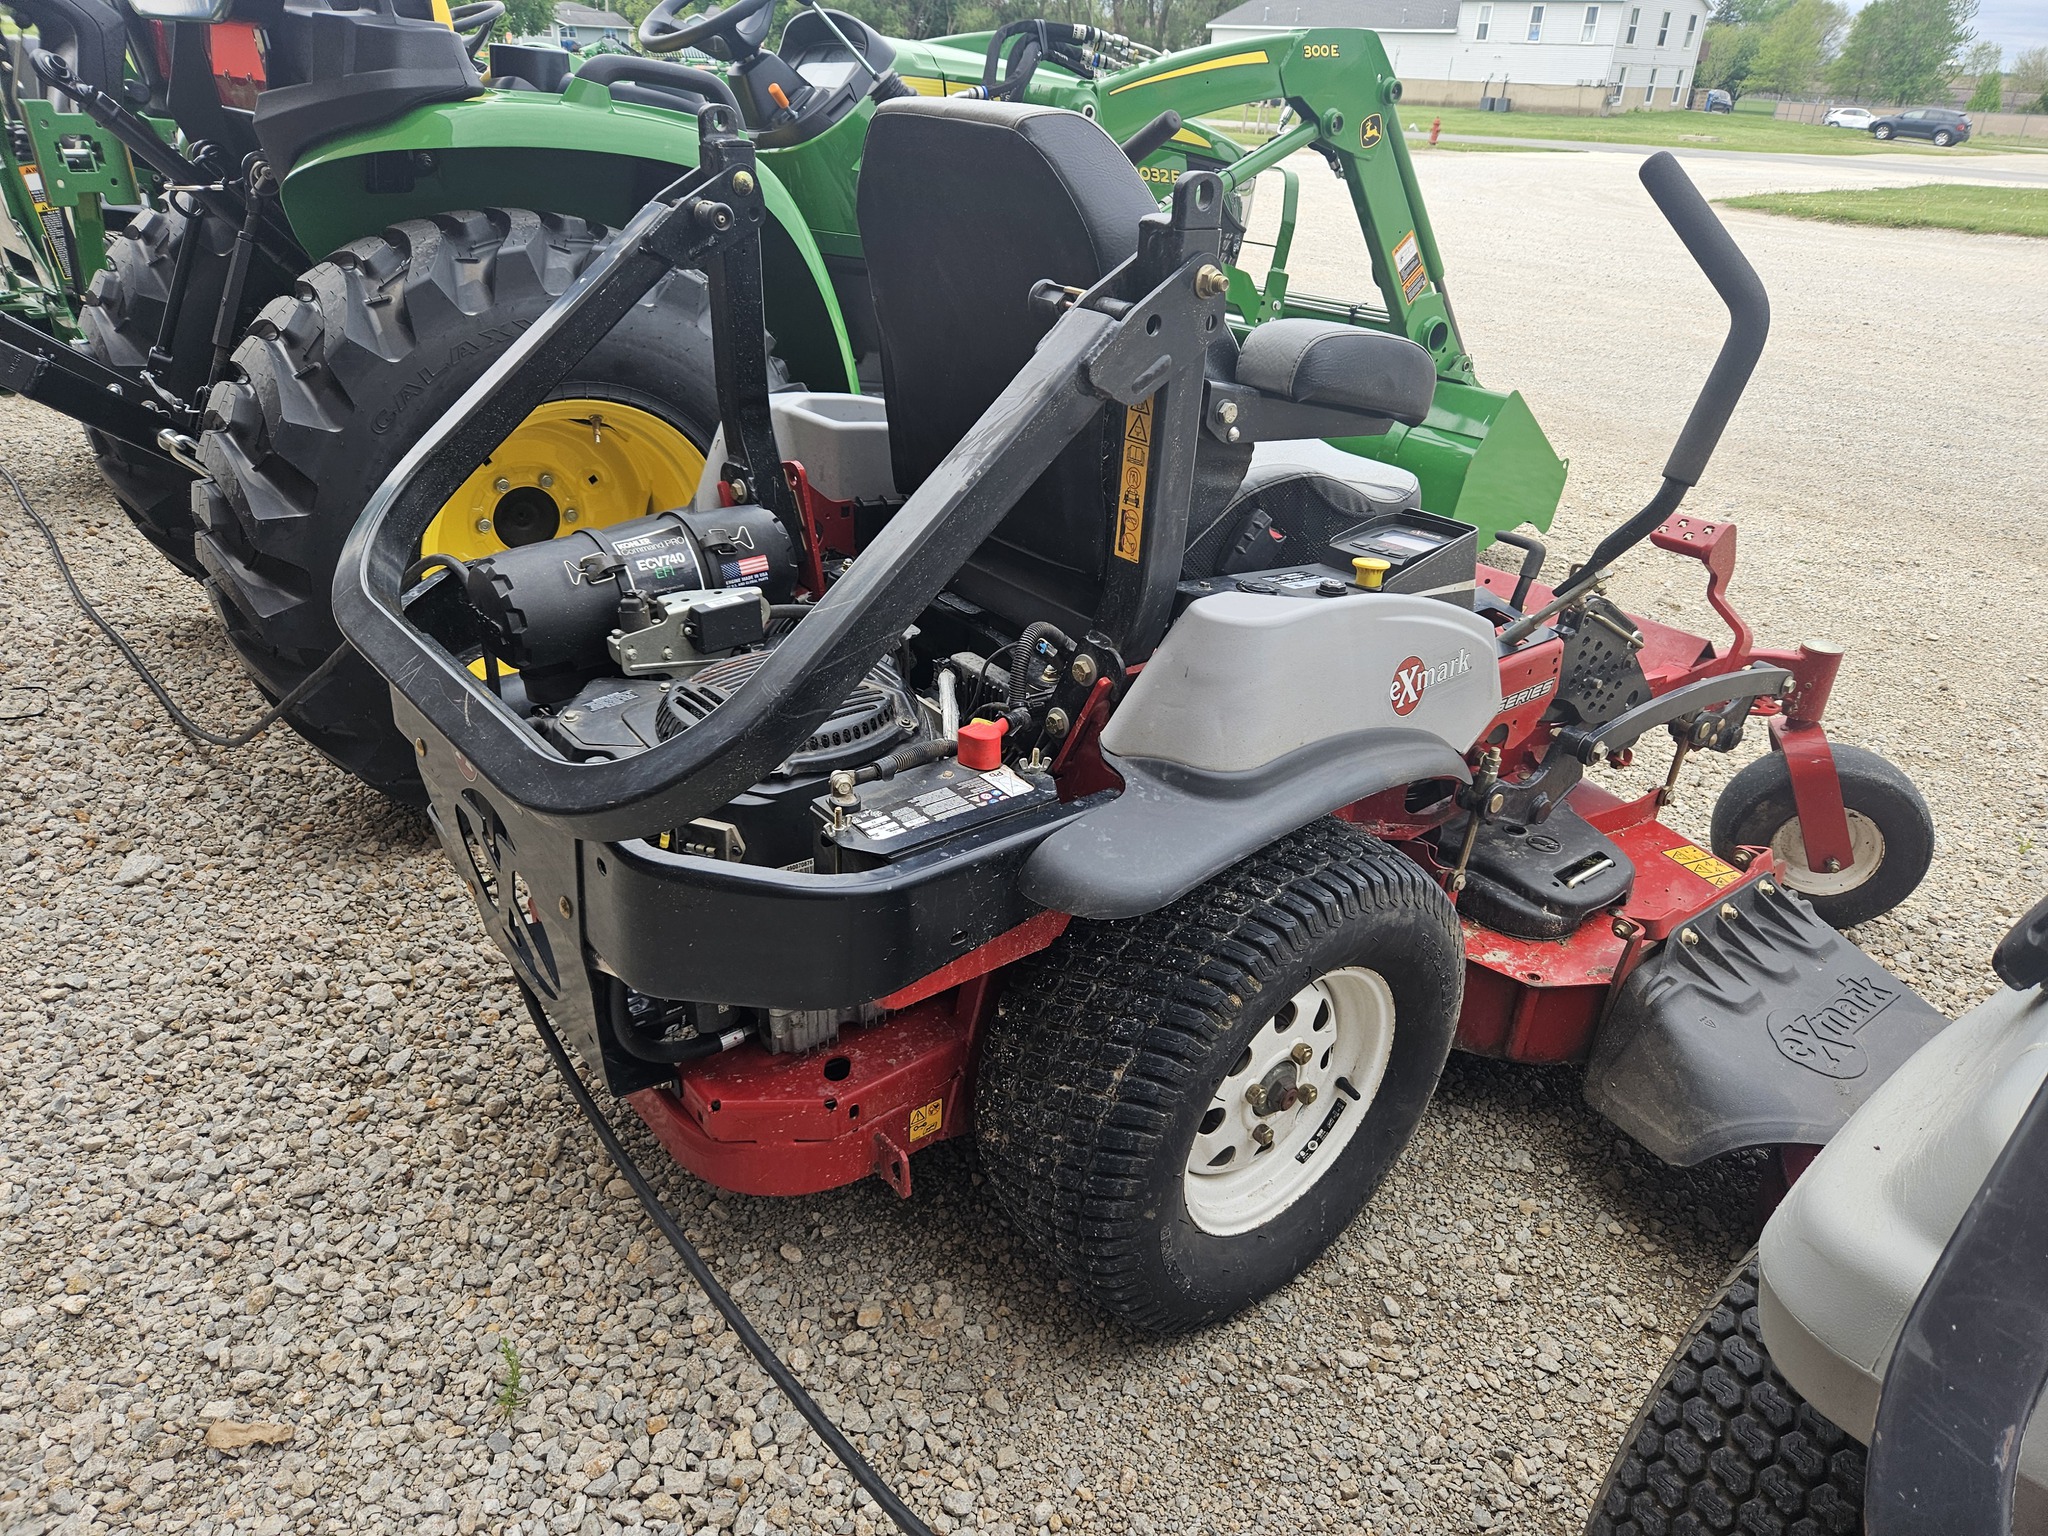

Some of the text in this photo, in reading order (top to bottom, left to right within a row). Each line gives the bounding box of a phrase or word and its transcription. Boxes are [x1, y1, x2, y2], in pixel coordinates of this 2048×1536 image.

[616, 538, 652, 550] KOHLER
[621, 536, 685, 556] Command PRO
[636, 552, 686, 571] ECV740
[655, 565, 675, 579] EFI
[1389, 648, 1471, 709] eXmark
[1498, 679, 1555, 712] SERIES
